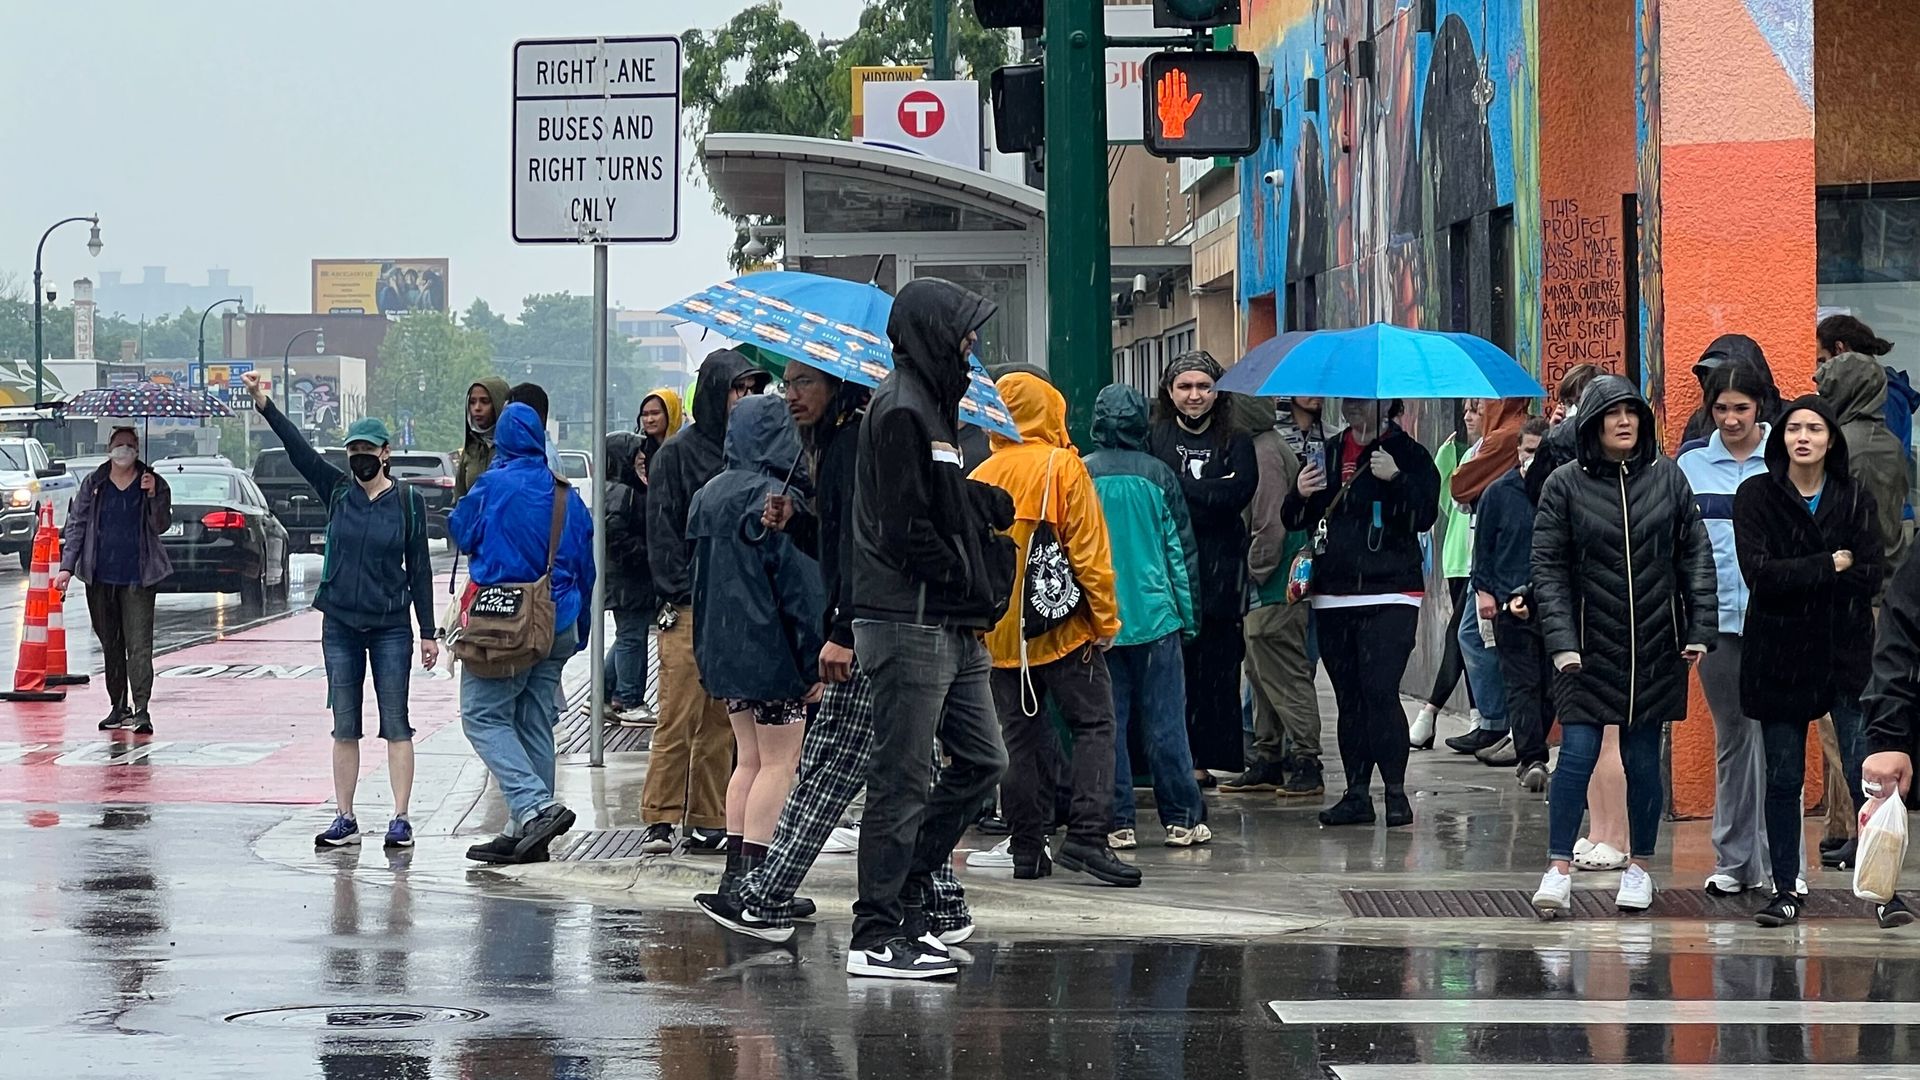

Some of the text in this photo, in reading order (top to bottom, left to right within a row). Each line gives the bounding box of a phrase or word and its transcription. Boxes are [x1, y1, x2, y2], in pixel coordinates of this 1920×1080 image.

[537, 56, 596, 85] RIGHT
[862, 71, 912, 82] MIDTOWN
[1105, 61, 1144, 90] GJI
[538, 115, 654, 142] BUSES AND
[903, 101, 939, 133] T
[529, 157, 587, 182] RIGHT
[1547, 198, 1579, 218] THIS
[1543, 214, 1609, 241] PROJECT
[1543, 236, 1618, 260] WAS MADE
[1545, 257, 1621, 281] POSSIBLE BY:
[1542, 303, 1552, 320] &
[1554, 300, 1582, 320] MAURO
[1546, 318, 1619, 342] LAKE STREET
[1548, 340, 1621, 360] COUNCIL,
[1030, 595, 1051, 618] MEIN
[1052, 605, 1069, 619] BIER
